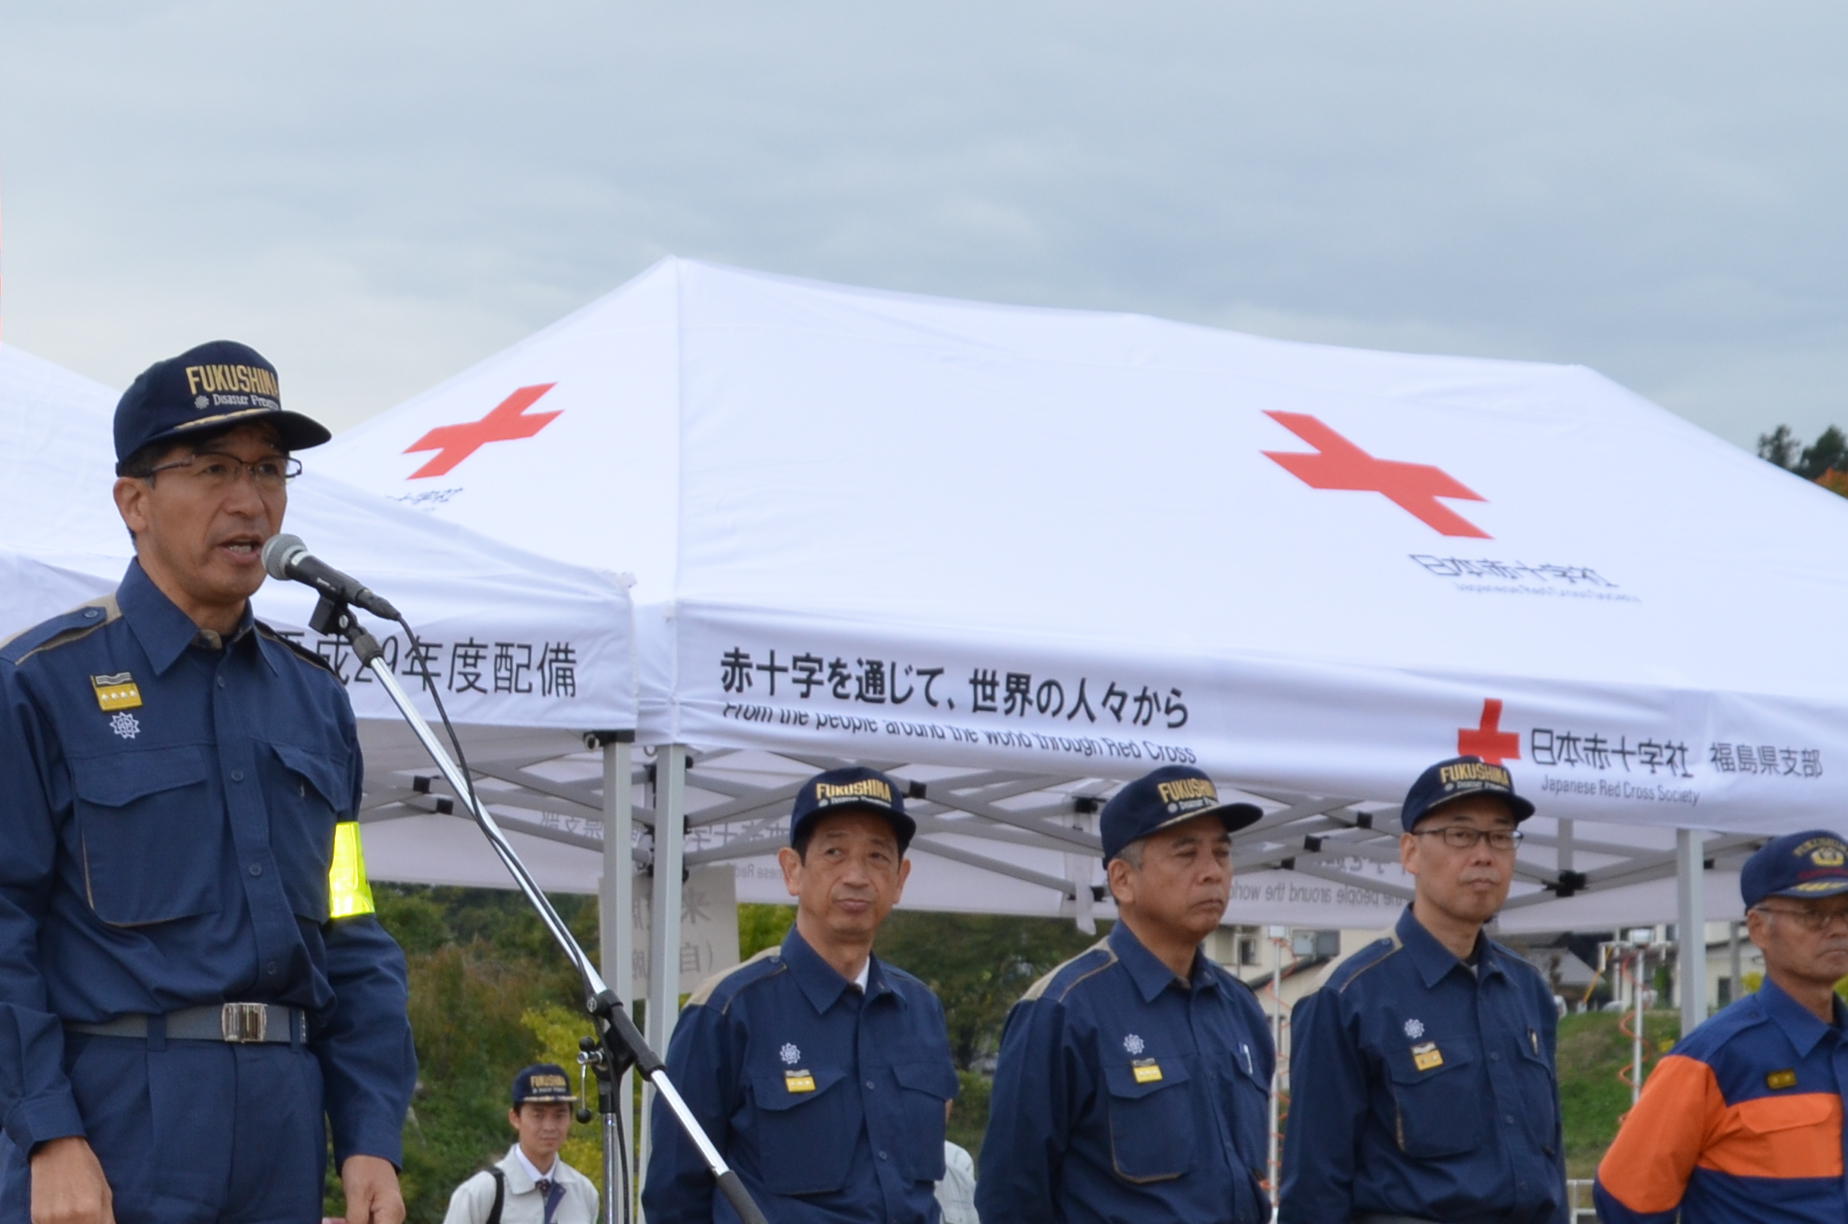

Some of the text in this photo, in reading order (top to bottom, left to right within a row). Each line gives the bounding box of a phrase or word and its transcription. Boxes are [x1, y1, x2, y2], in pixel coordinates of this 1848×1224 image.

[1531, 728, 1824, 779] 日本赤十字社 福島県支部
[1439, 763, 1511, 787] FUKUSHIMA
[816, 779, 892, 803] FUKUSHIMA
[1542, 775, 1701, 807] Japanese Red Cross Society
